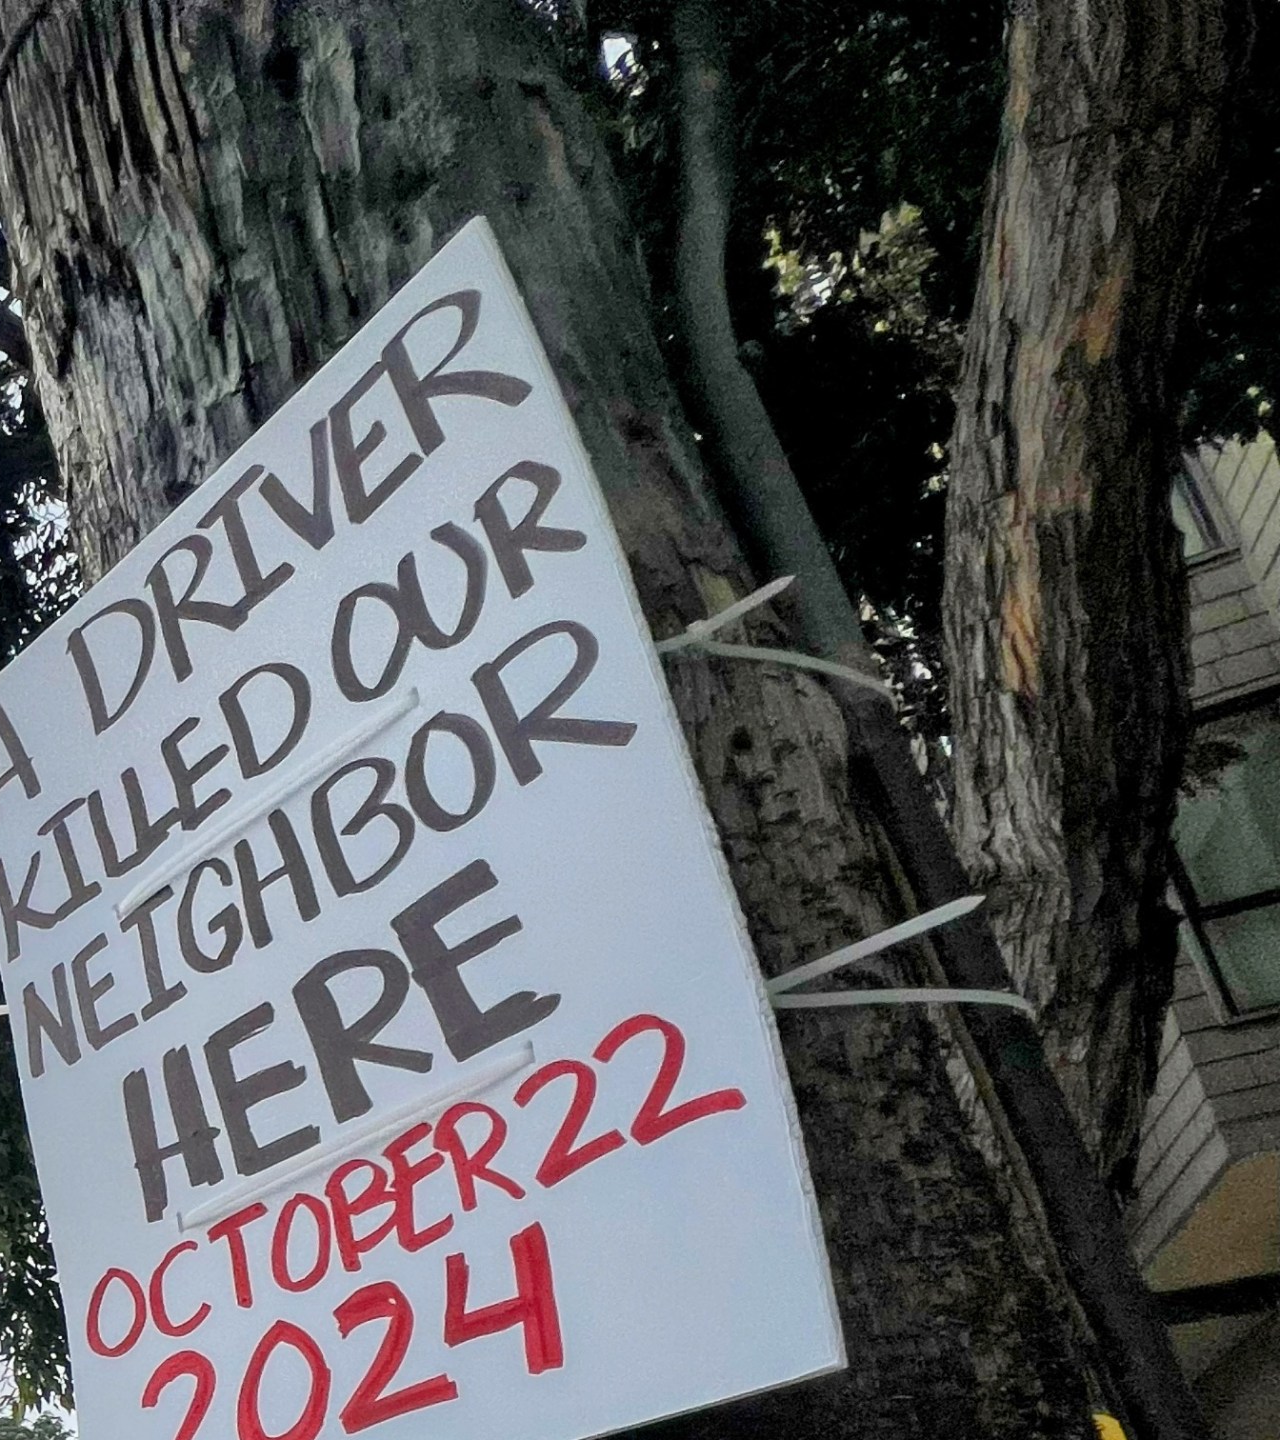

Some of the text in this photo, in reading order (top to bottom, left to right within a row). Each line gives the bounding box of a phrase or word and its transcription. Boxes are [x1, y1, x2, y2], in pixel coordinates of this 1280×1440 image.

[66, 287, 533, 732] DRIVER
[330, 459, 587, 703] OUR
[22, 618, 637, 1079] NEIGHBOR
[85, 1012, 748, 1358] OCTOBER 22
[122, 857, 562, 1223] HERE
